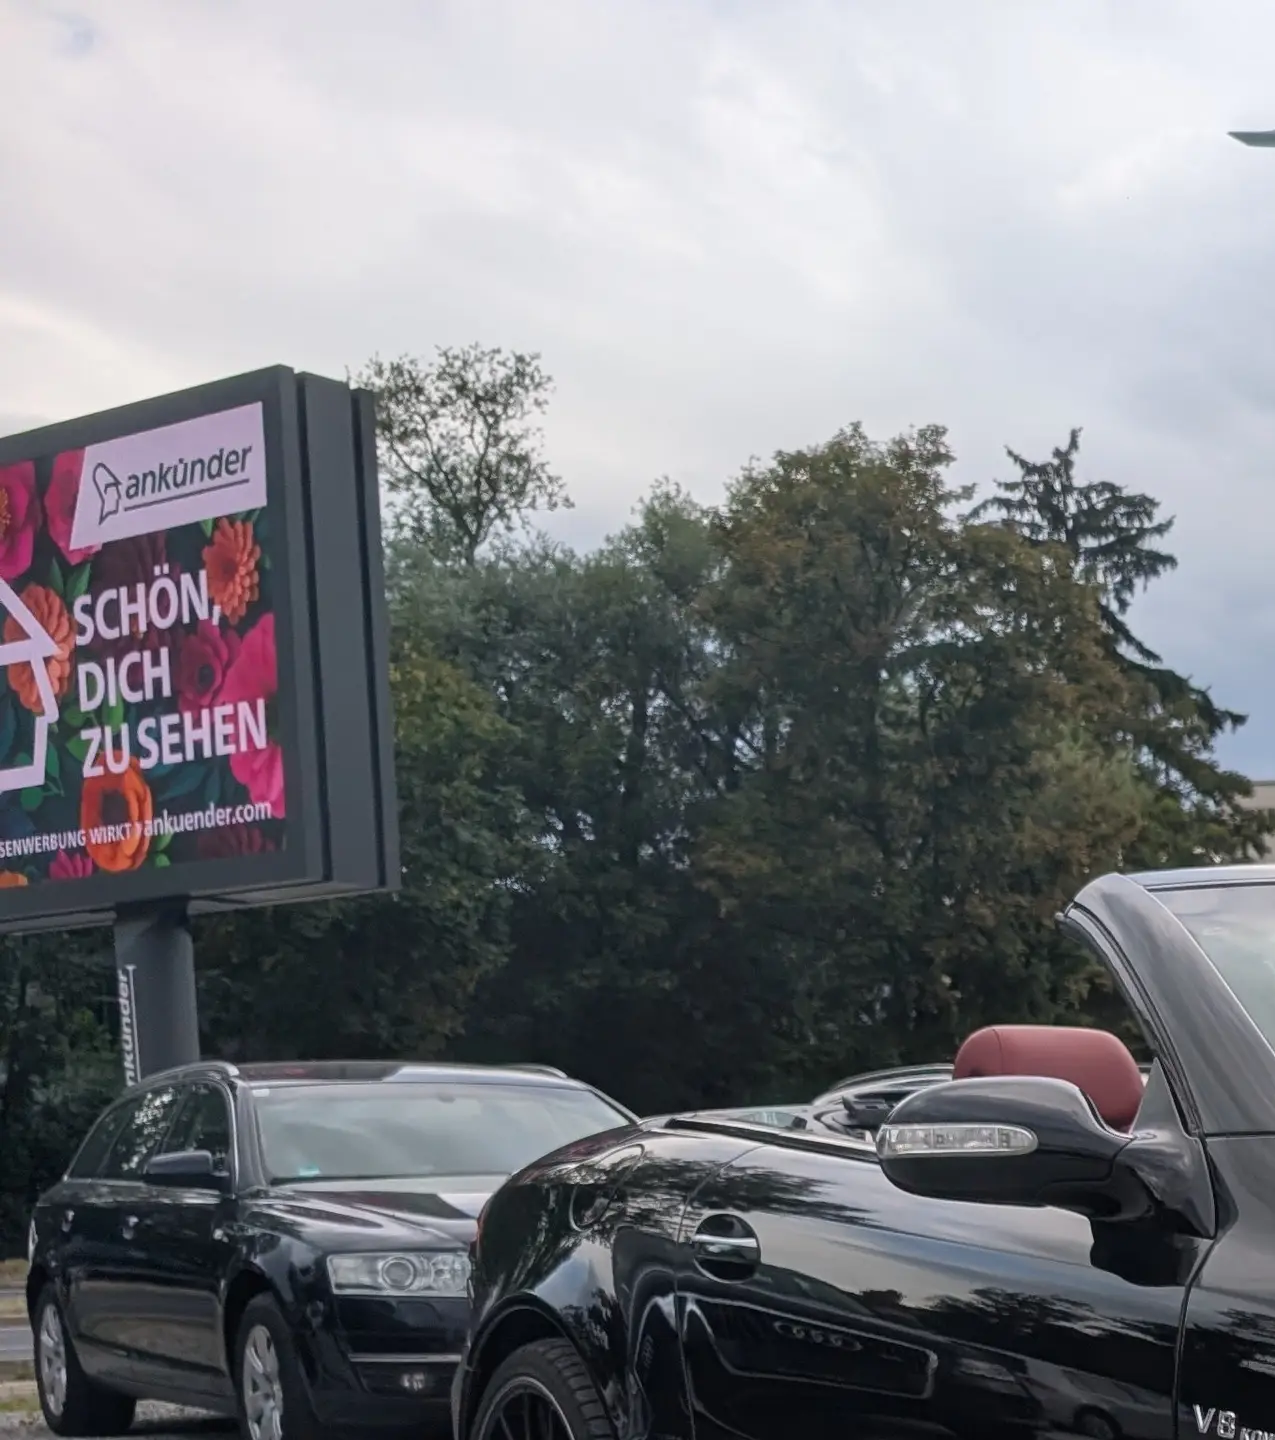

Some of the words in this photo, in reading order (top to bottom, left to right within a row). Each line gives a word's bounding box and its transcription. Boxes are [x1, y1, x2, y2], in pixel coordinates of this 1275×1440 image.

[74, 563, 221, 646] SCHÖN,
[77, 646, 172, 713] DICH
[81, 728, 132, 778] ZU
[139, 697, 268, 767] SEHEN
[89, 823, 132, 846] WIRKT
[144, 801, 272, 837] ankuender.com
[1193, 1404, 1236, 1439] V8
